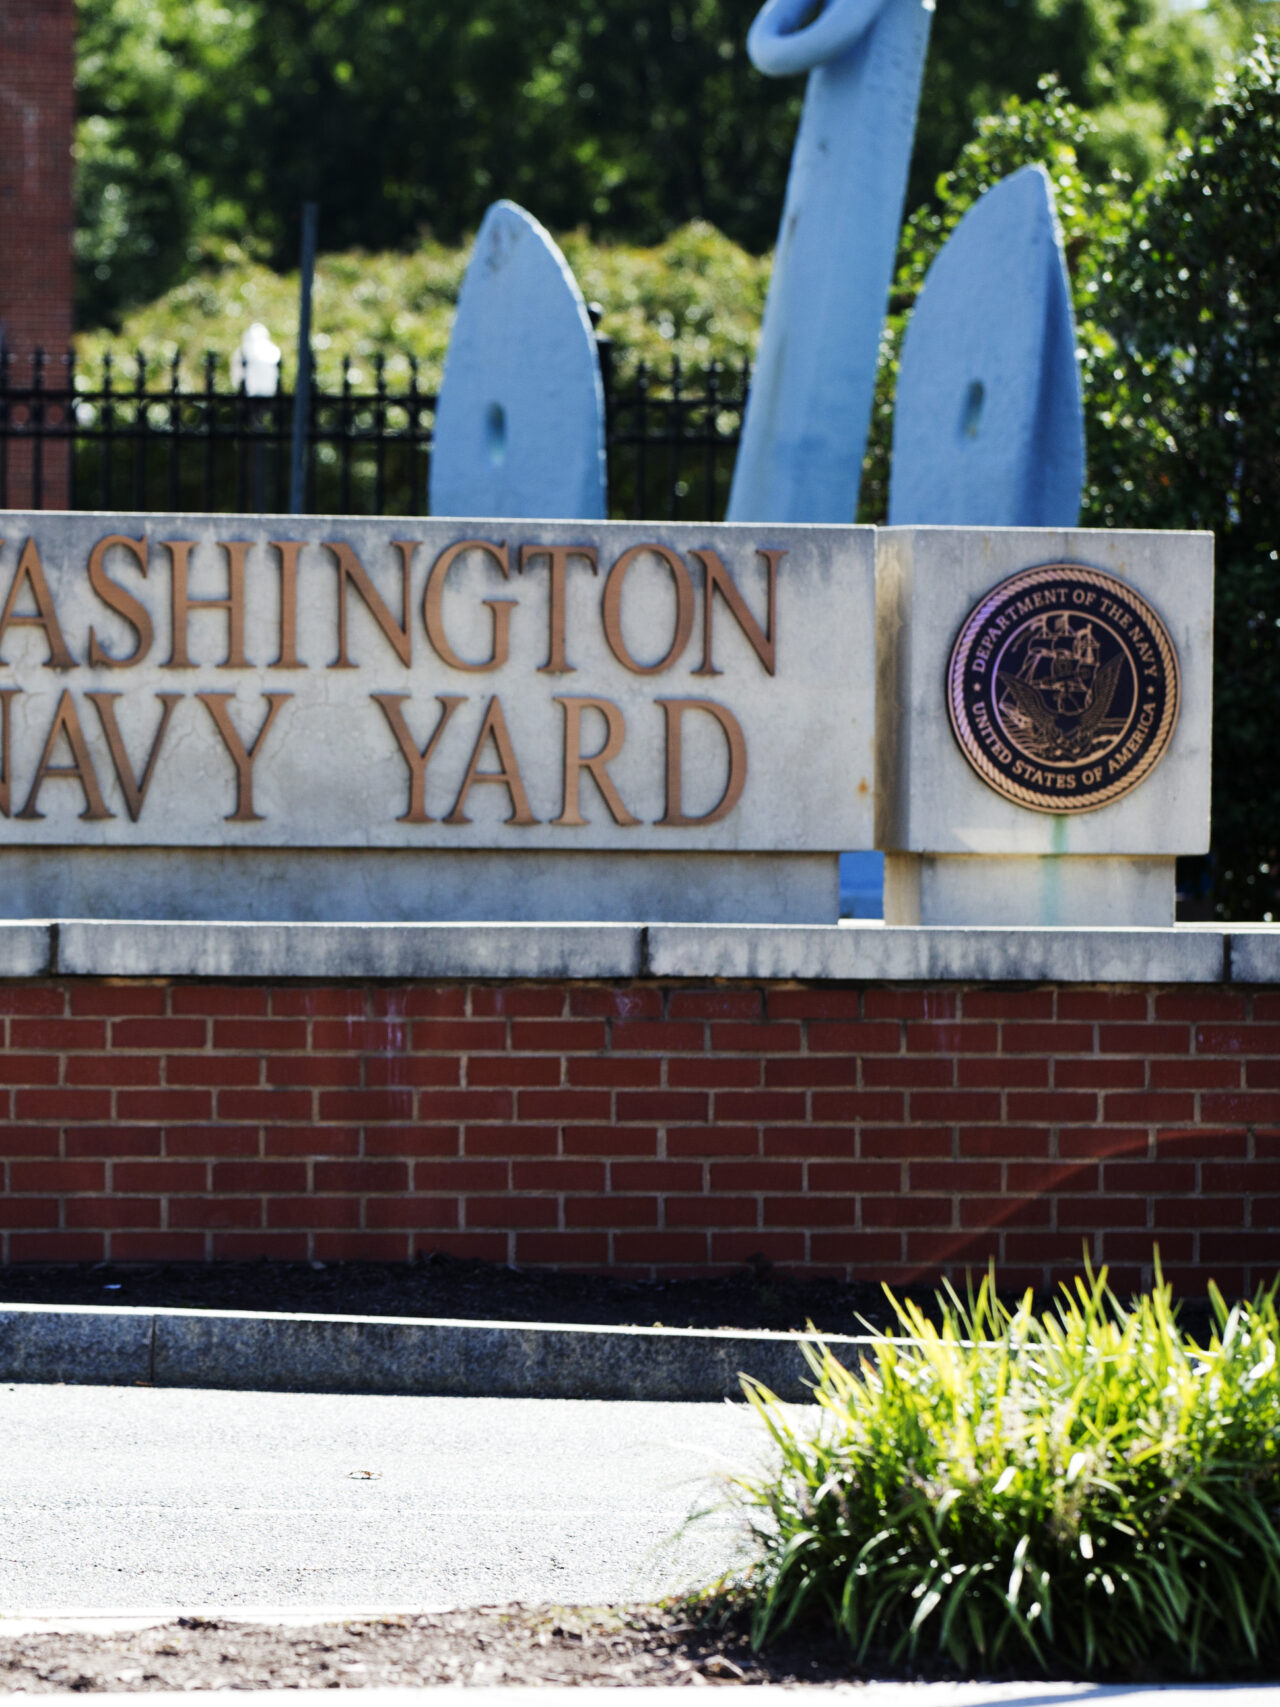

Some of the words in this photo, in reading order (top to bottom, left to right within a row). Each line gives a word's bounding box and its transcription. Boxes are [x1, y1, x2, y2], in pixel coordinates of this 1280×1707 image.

[972, 589, 1069, 674] DEPARTMENT
[1072, 588, 1096, 606] OF
[1100, 597, 1133, 630] THE
[1128, 626, 1158, 678] NAVY
[371, 693, 748, 828] YARD
[972, 701, 1012, 765] UNITED
[1012, 761, 1077, 789] STATES
[1082, 767, 1103, 786] OF
[1108, 702, 1156, 774] AMERICA
